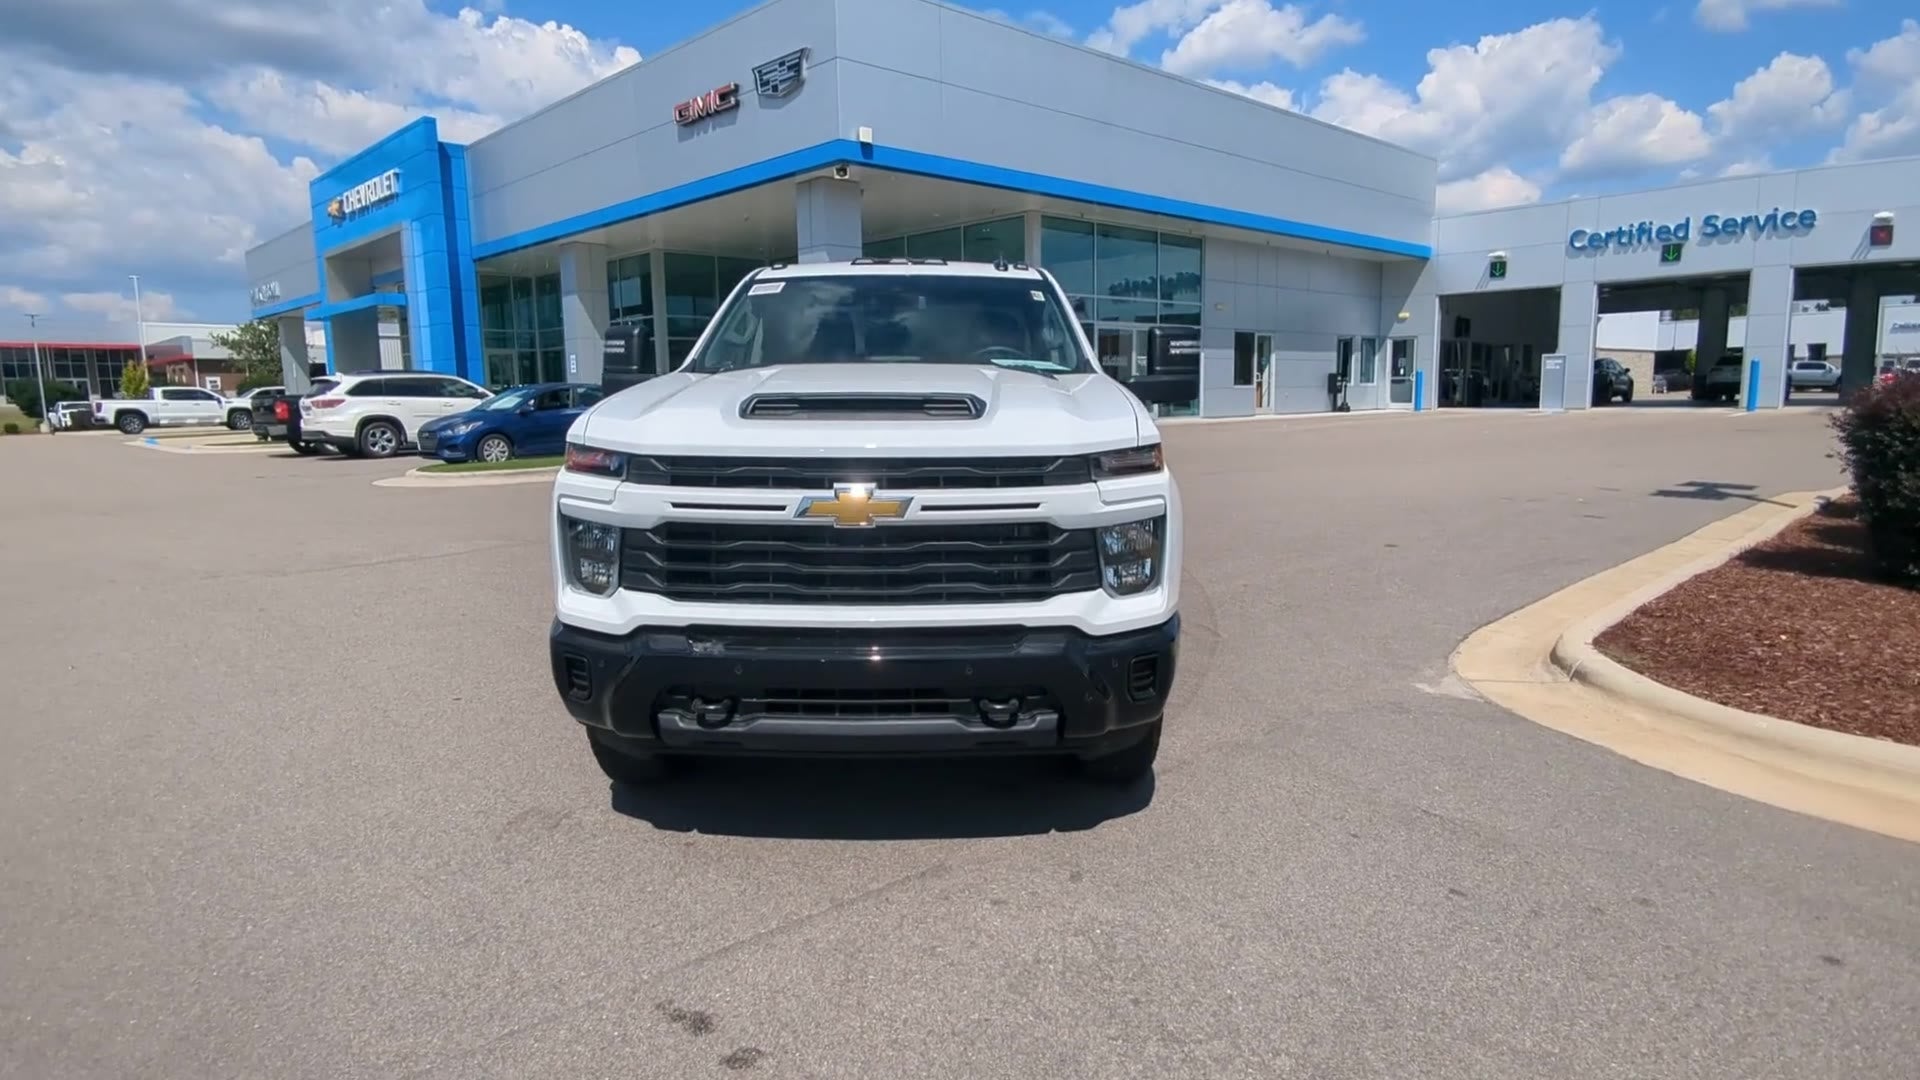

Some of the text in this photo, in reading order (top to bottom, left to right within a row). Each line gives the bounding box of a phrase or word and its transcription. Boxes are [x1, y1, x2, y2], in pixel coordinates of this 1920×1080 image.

[673, 82, 738, 125] GMC
[342, 167, 402, 213] CHEVROLET
[1569, 206, 1817, 251] Certified Service
